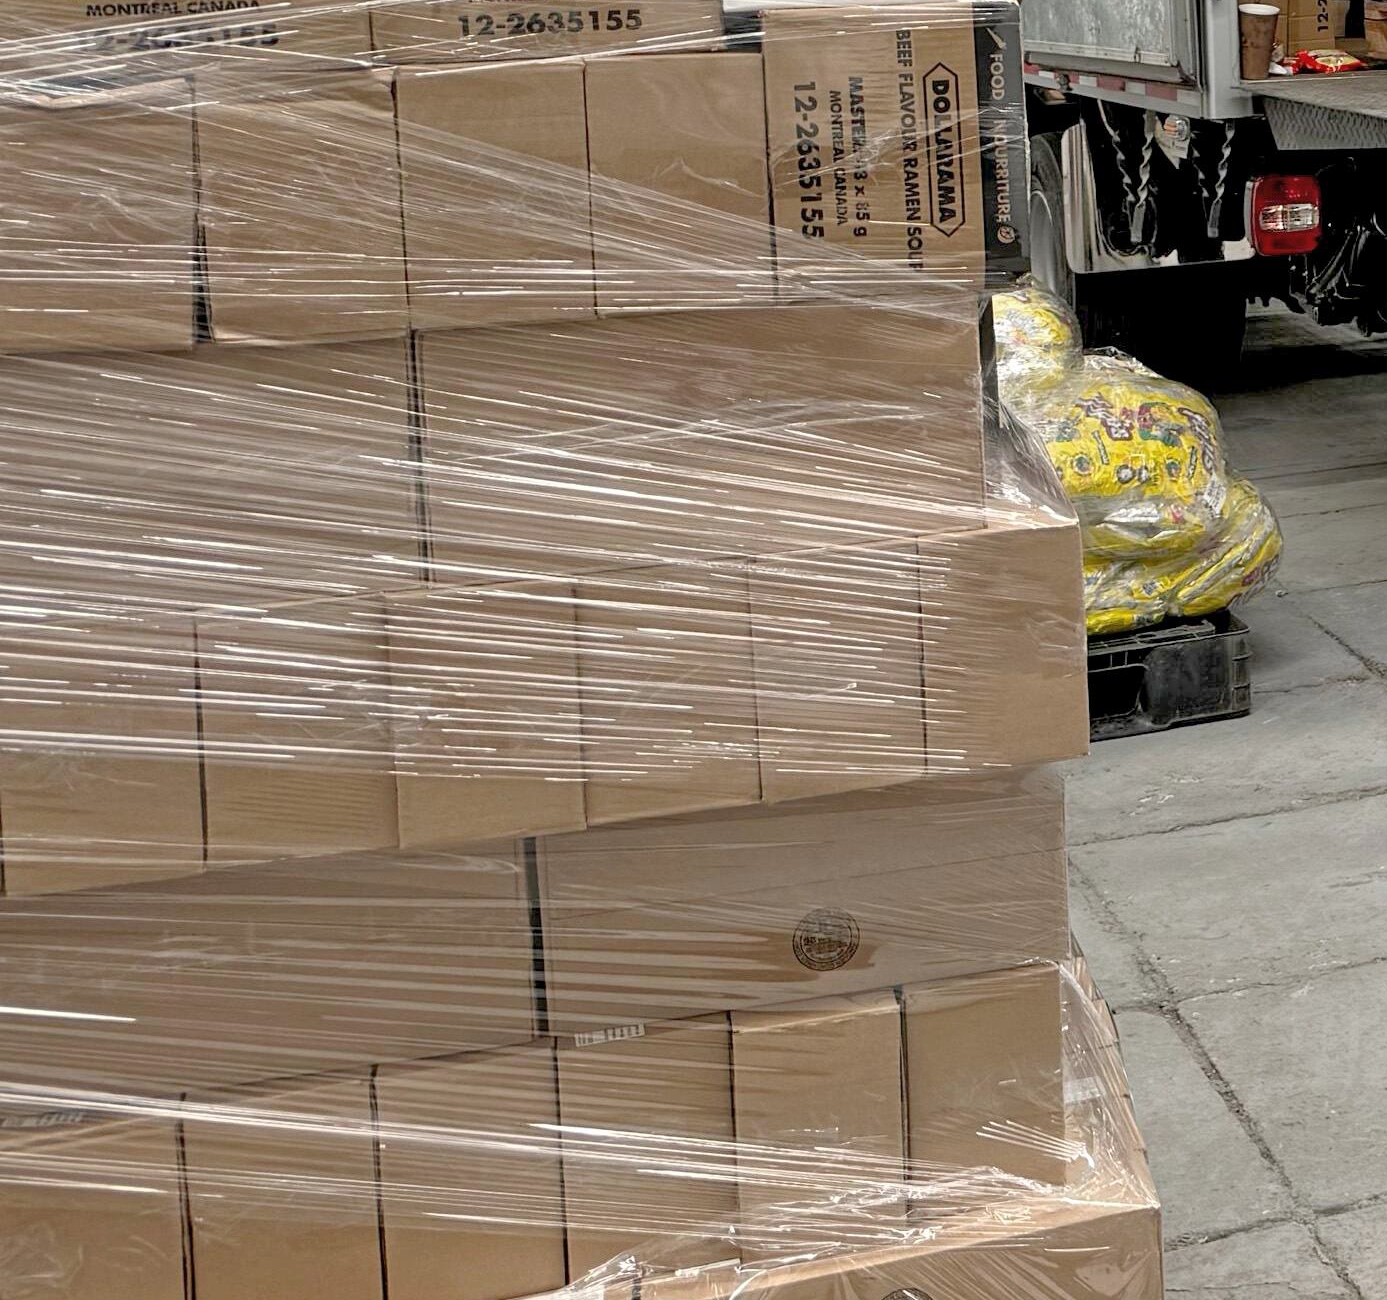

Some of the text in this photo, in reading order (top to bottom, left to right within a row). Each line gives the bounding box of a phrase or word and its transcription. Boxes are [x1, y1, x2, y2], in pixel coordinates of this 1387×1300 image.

[86, 3, 181, 18] MONTREAL
[458, 8, 643, 37] 12-2635155
[896, 29, 913, 67] BEEF
[899, 73, 918, 153] FLAVOUR
[990, 53, 1012, 223] FOOD NOURRITURE
[794, 81, 825, 239] 12-2635155
[829, 90, 848, 226] MONTREAL CANADA
[931, 79, 957, 223] DOLLARAMA
[903, 158, 921, 221] RAMEN
[853, 226, 869, 238] g
